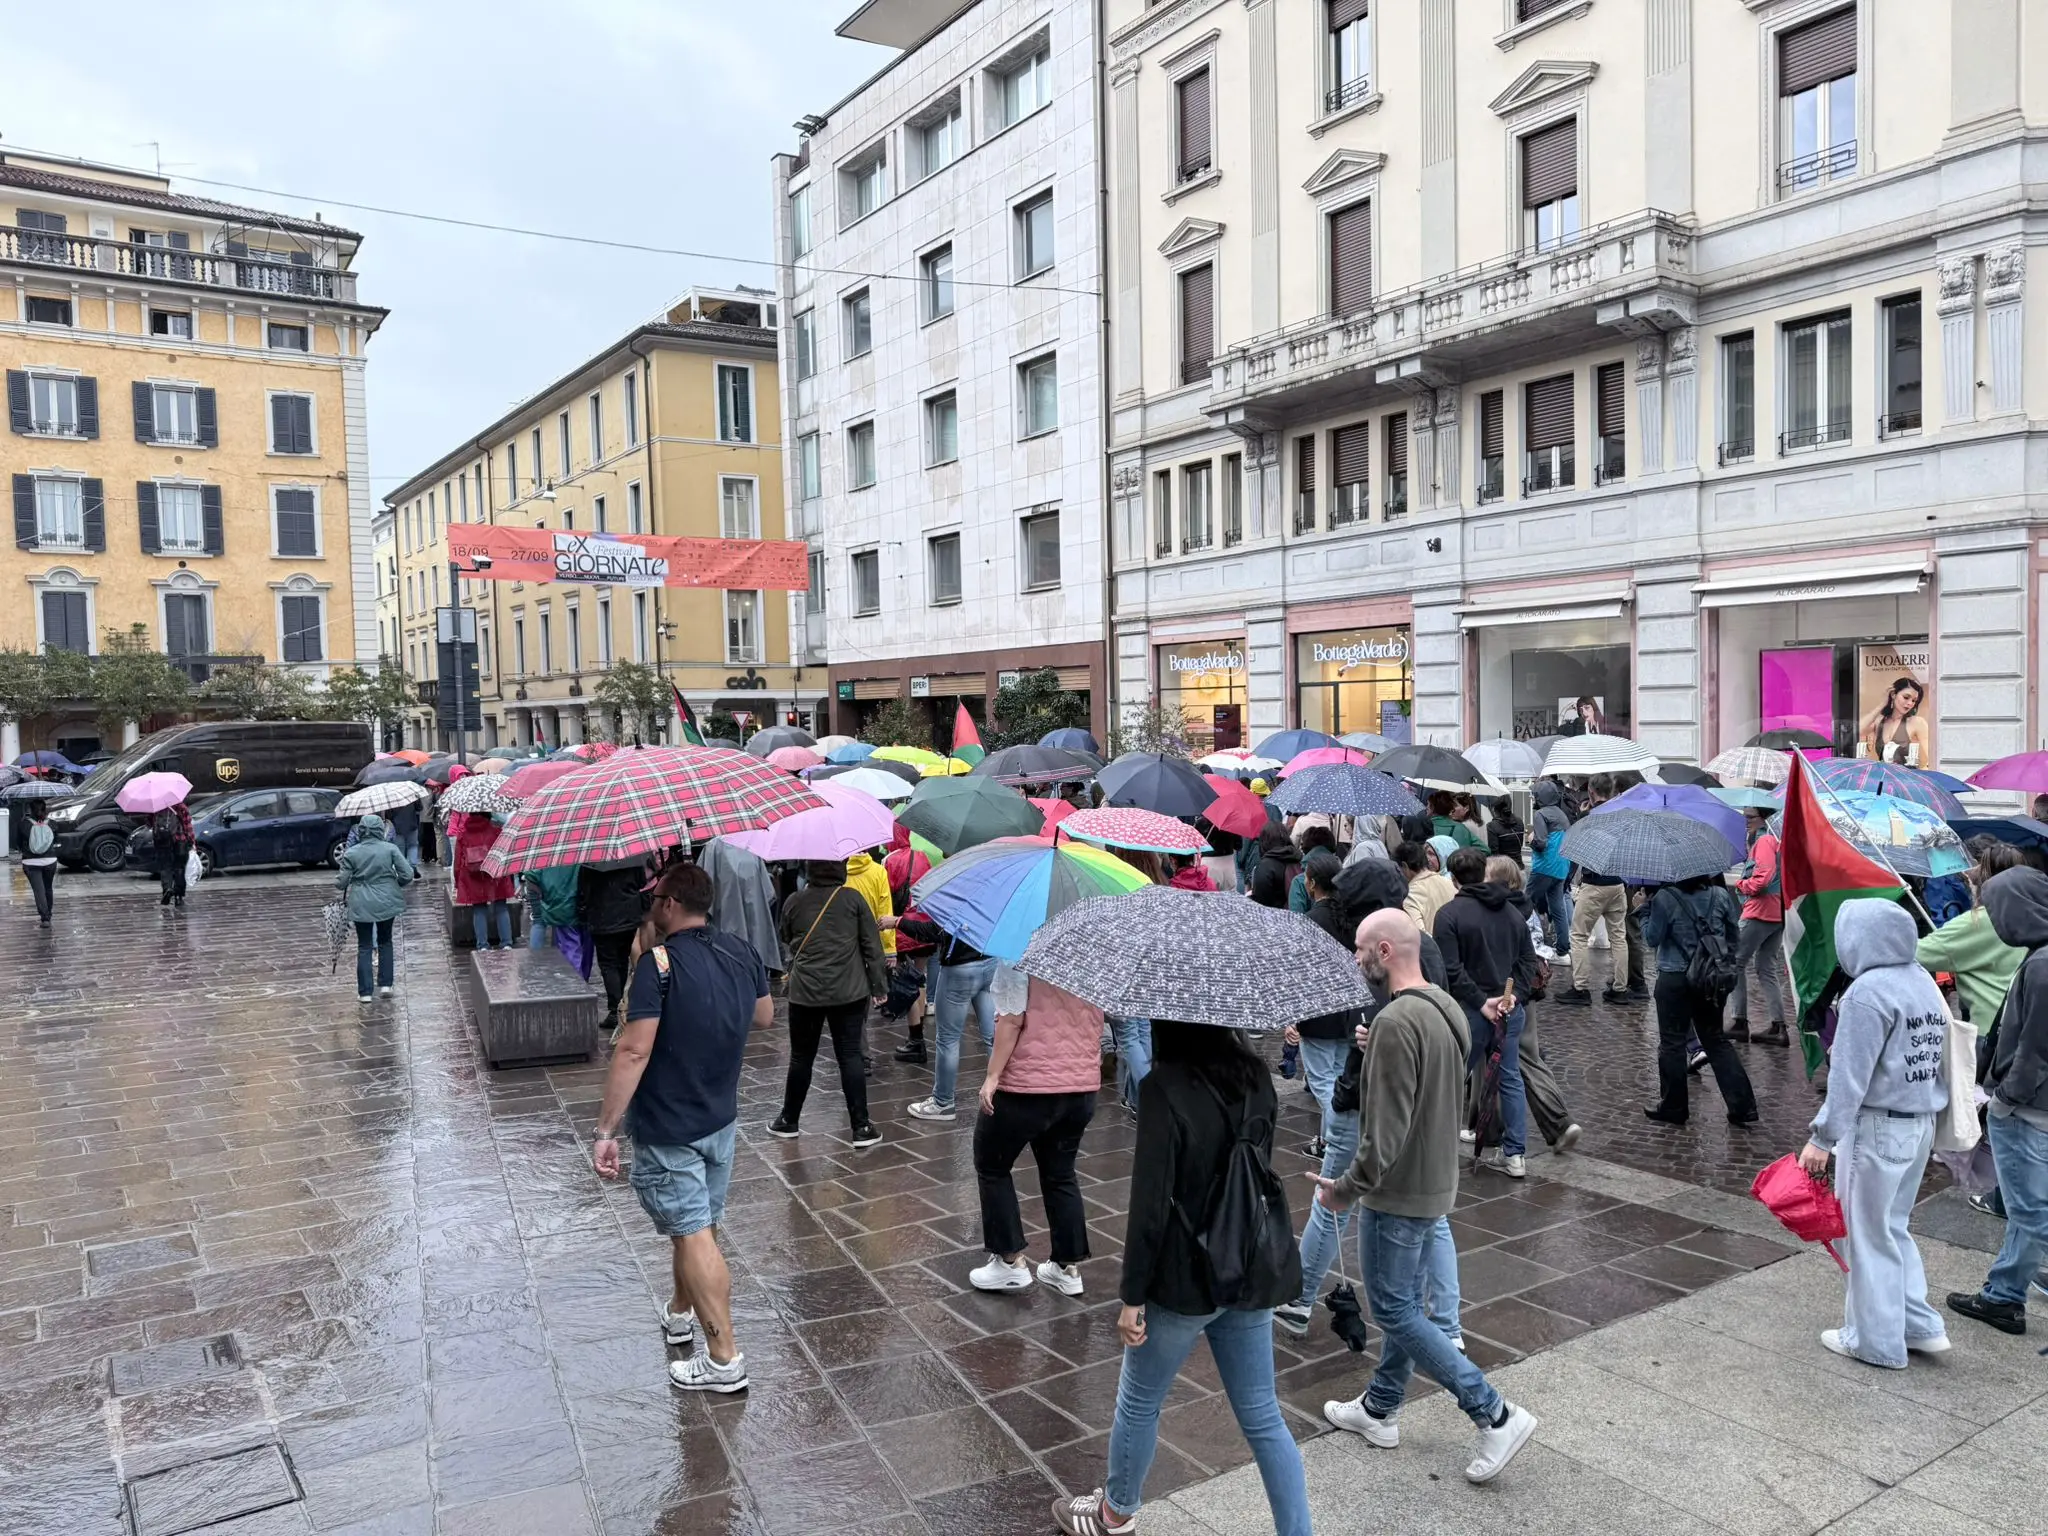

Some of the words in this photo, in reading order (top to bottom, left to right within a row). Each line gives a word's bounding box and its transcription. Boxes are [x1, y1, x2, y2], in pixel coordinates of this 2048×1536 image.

[452, 546, 489, 557] 18/09
[511, 550, 549, 562] 27/09
[726, 667, 767, 690] coin
[219, 765, 238, 779] ups
